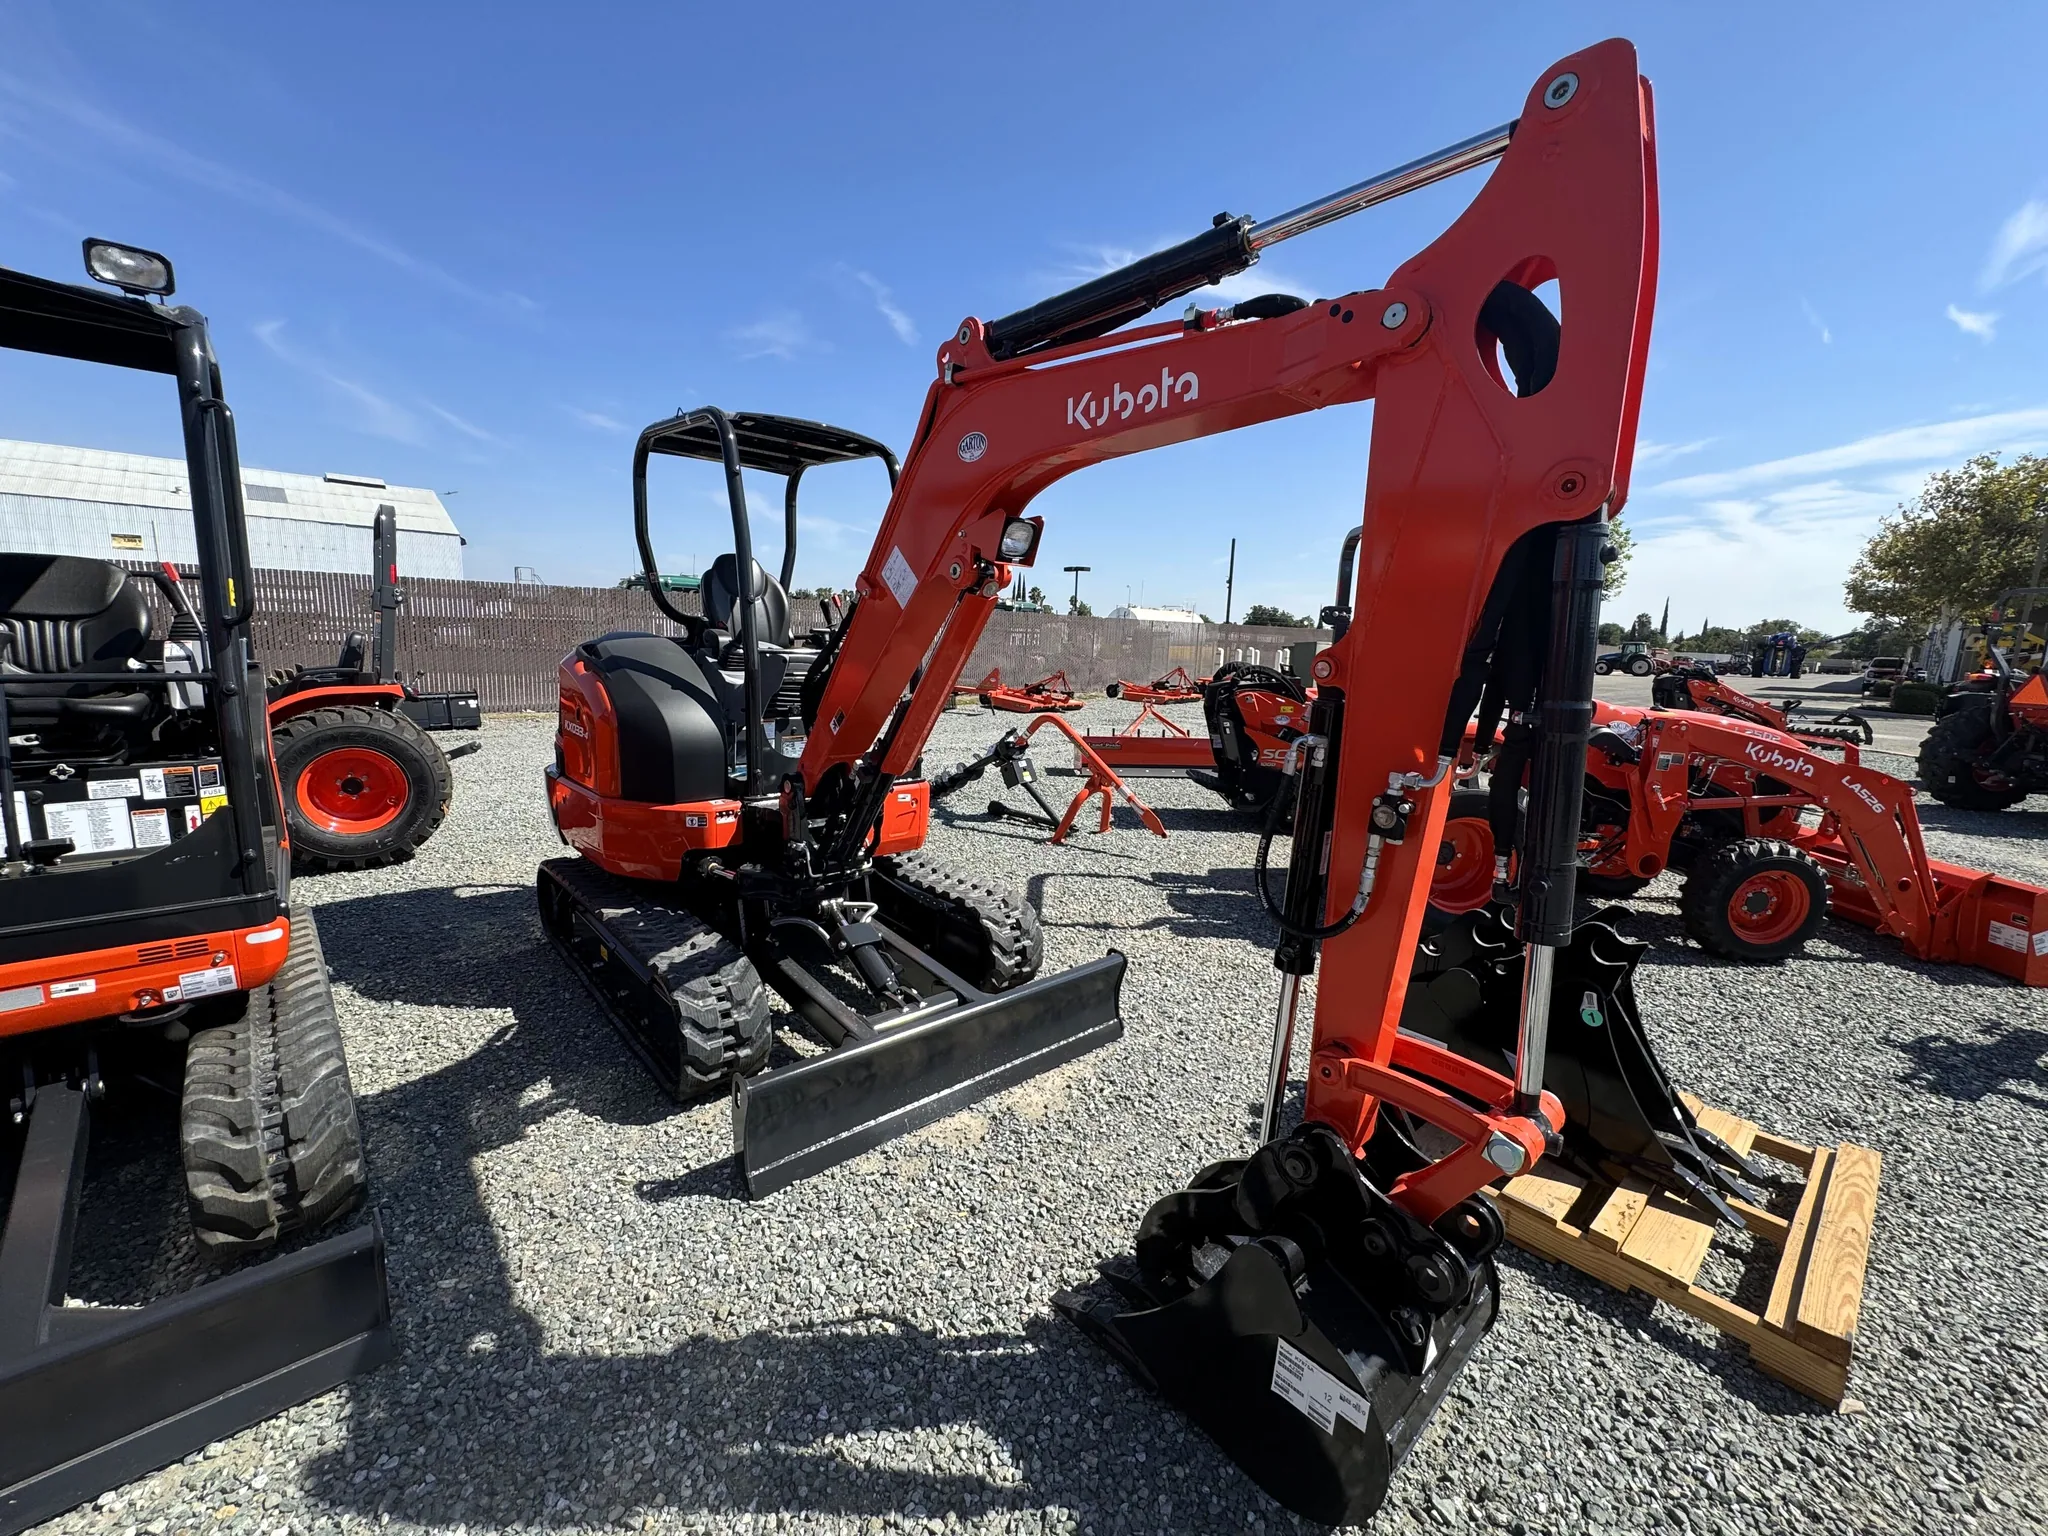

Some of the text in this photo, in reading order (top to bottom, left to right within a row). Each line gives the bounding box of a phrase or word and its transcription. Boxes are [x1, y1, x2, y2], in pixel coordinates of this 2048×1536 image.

[1067, 367, 1199, 430] Kubota
[1732, 695, 1755, 709] Kubota
[1745, 741, 1814, 777] Kubota
[203, 788, 223, 796] FUSE
[1841, 775, 1886, 814] LA526
[1587, 1011, 1596, 1024] 1
[1323, 1392, 1333, 1405] 12
